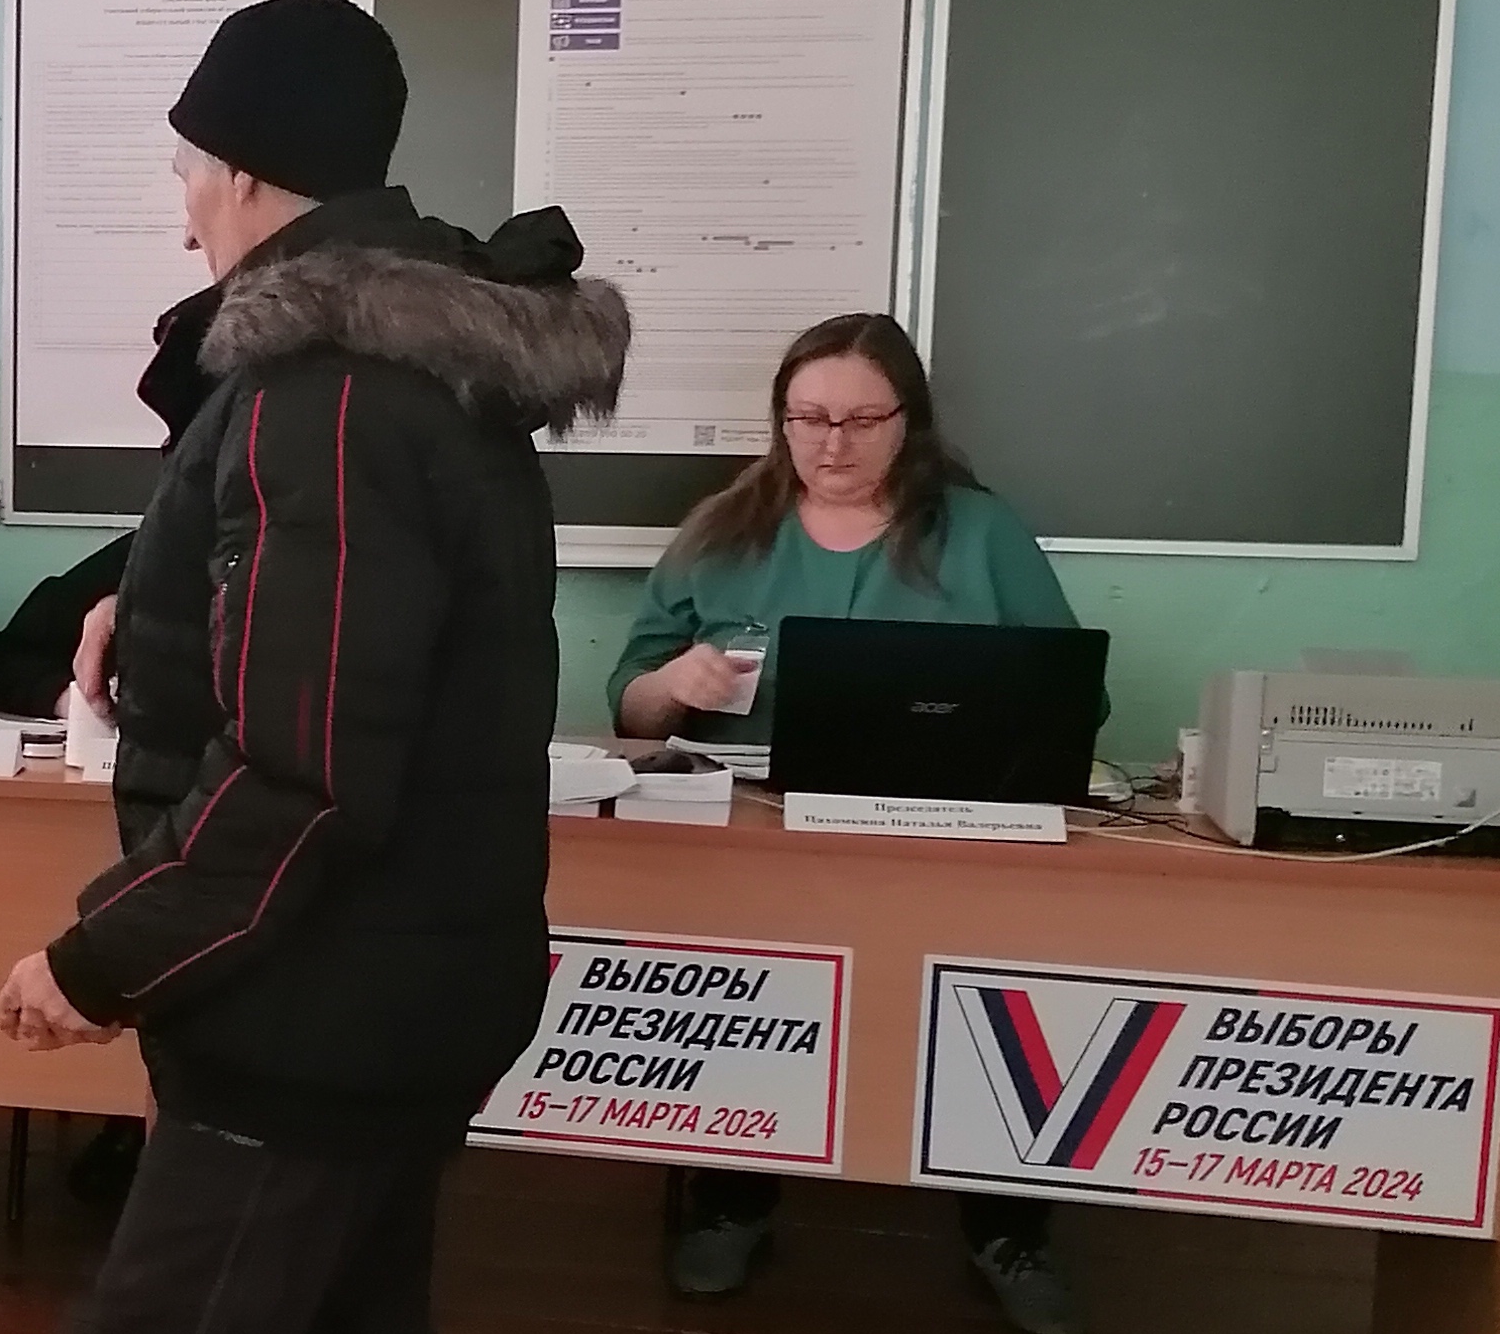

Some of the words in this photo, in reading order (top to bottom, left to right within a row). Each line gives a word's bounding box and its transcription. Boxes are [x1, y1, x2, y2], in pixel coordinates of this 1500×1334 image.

[911, 701, 959, 714] acer
[874, 802, 974, 814] Председатель
[580, 957, 770, 1002] ВЫБОРЫ
[556, 1002, 822, 1055] ПРЕЗИДЕНТА
[1205, 1007, 1419, 1057] ВЫБОРЫ
[533, 1046, 705, 1092] РОССИИ
[1178, 1055, 1475, 1113] ПРЕЗИДЕНТА
[599, 1097, 701, 1133] МАРТА
[704, 1107, 779, 1140] 2024
[1152, 1101, 1344, 1150] РОССИИ
[1223, 1155, 1339, 1194] МАРТА
[1341, 1168, 1424, 1201] 2024
